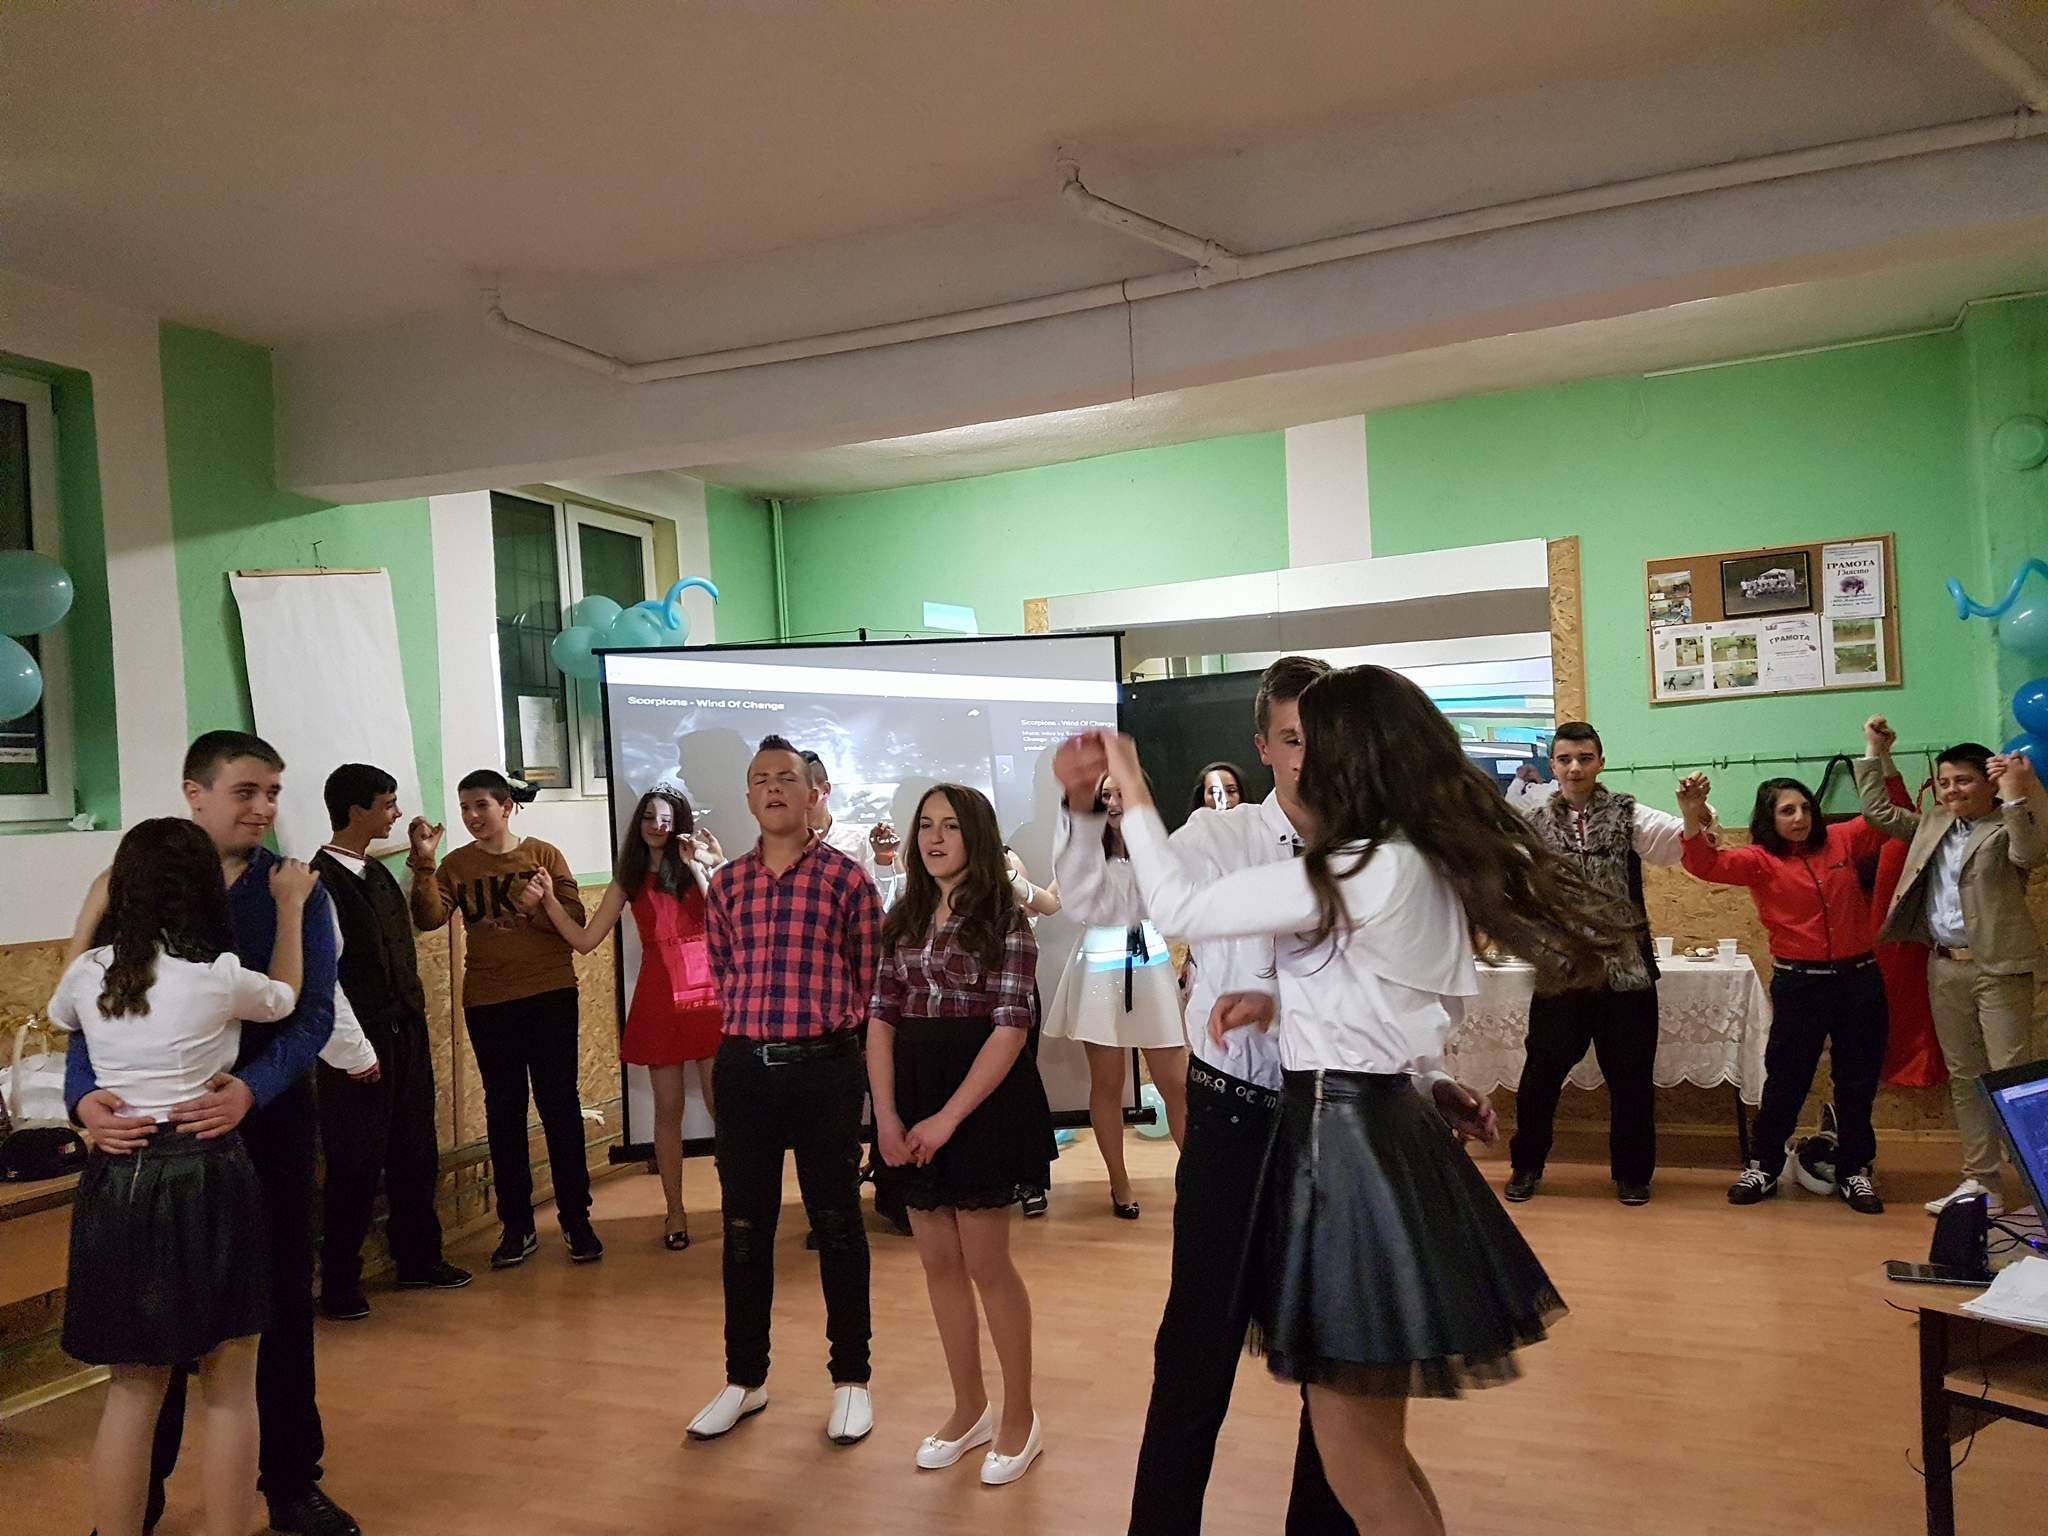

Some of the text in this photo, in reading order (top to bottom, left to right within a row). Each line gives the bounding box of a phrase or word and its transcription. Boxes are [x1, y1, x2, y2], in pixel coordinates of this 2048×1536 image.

[1826, 559, 1876, 571] ГРАМОТА
[1769, 634, 1811, 646] ГРАМОТА
[627, 696, 689, 707] Scorpions
[695, 699, 726, 708] Wind
[727, 700, 741, 708] Of
[742, 701, 785, 711] Change
[1020, 719, 1057, 727] Scorpions
